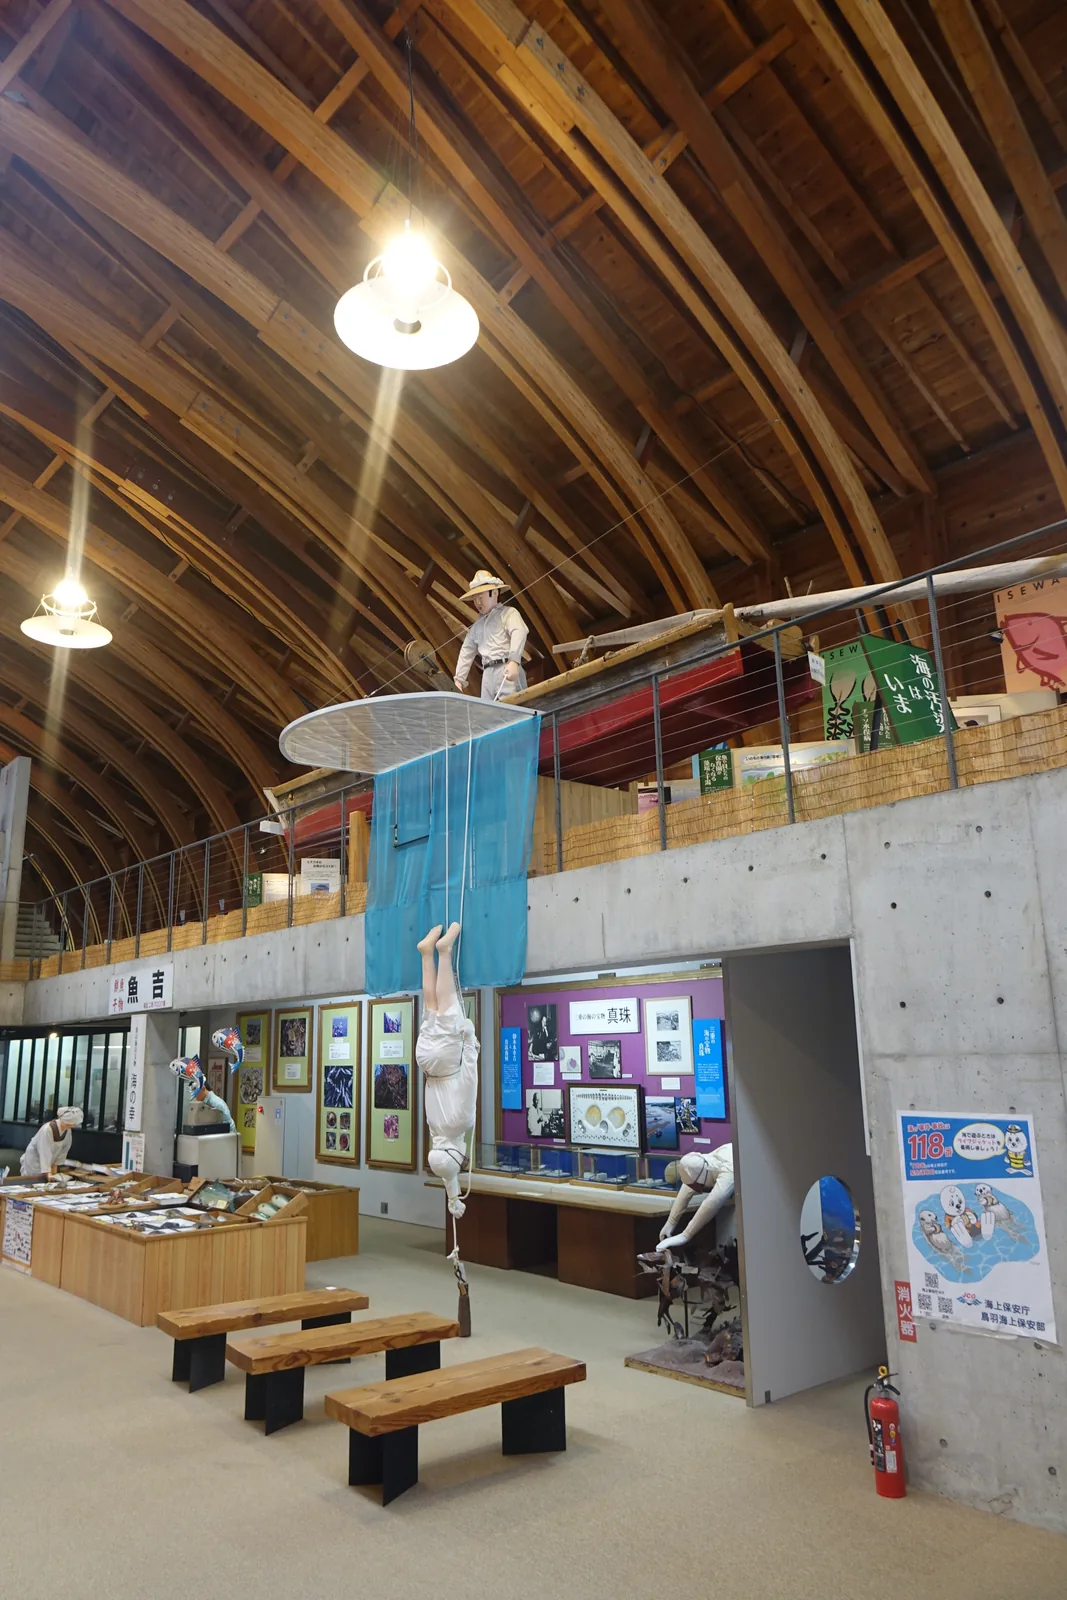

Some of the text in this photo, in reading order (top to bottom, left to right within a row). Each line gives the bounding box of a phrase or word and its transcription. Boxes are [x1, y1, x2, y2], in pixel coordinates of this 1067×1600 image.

[884, 673, 912, 713] いま
[908, 685, 924, 700] は
[607, 1006, 632, 1024] 真珠
[897, 1286, 915, 1336] 消火器
[984, 1299, 1030, 1316] 海上保安庁
[981, 1311, 1046, 1332] 鳥羽海上保安部
